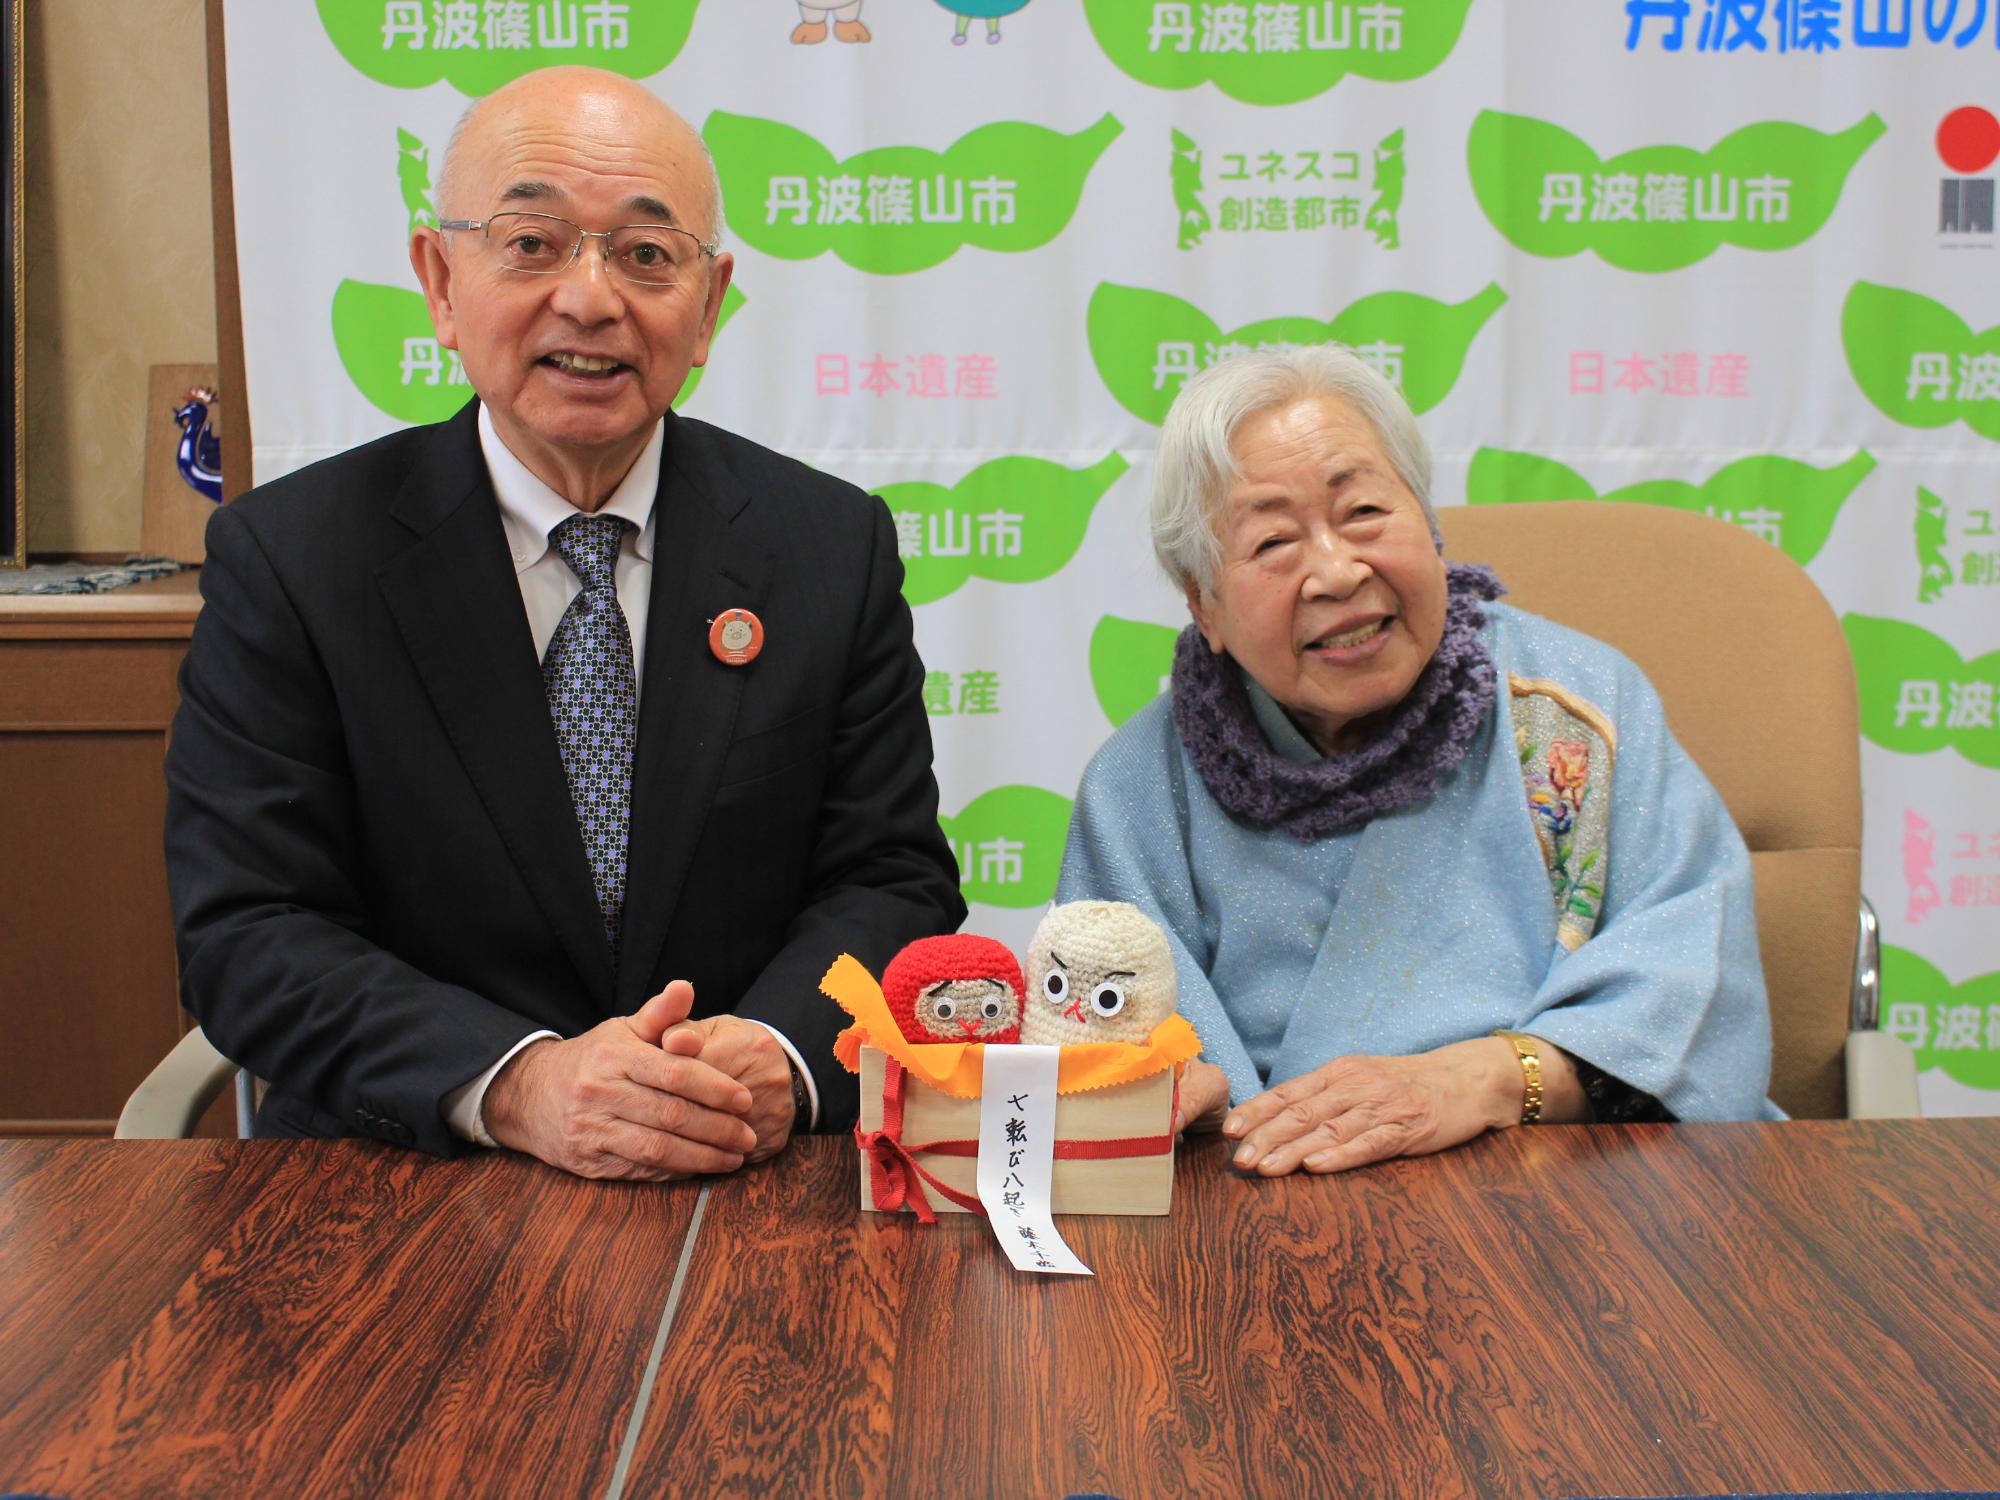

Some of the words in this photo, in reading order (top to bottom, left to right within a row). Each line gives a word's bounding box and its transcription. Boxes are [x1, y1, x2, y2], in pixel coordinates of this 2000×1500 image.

[381, 0, 630, 50] 丹波篠山市
[1147, 1, 1403, 53] 丹波篠山市
[1624, 0, 2000, 55] 丹波篠山の
[1219, 151, 1360, 182] ユネスコ
[765, 174, 1017, 226] 丹波篠山市
[1219, 196, 1361, 232] 創造都市
[1538, 172, 1792, 224] 丹波篠山市
[815, 354, 998, 400] 日本遺産
[1568, 350, 1752, 398] 日本遺産
